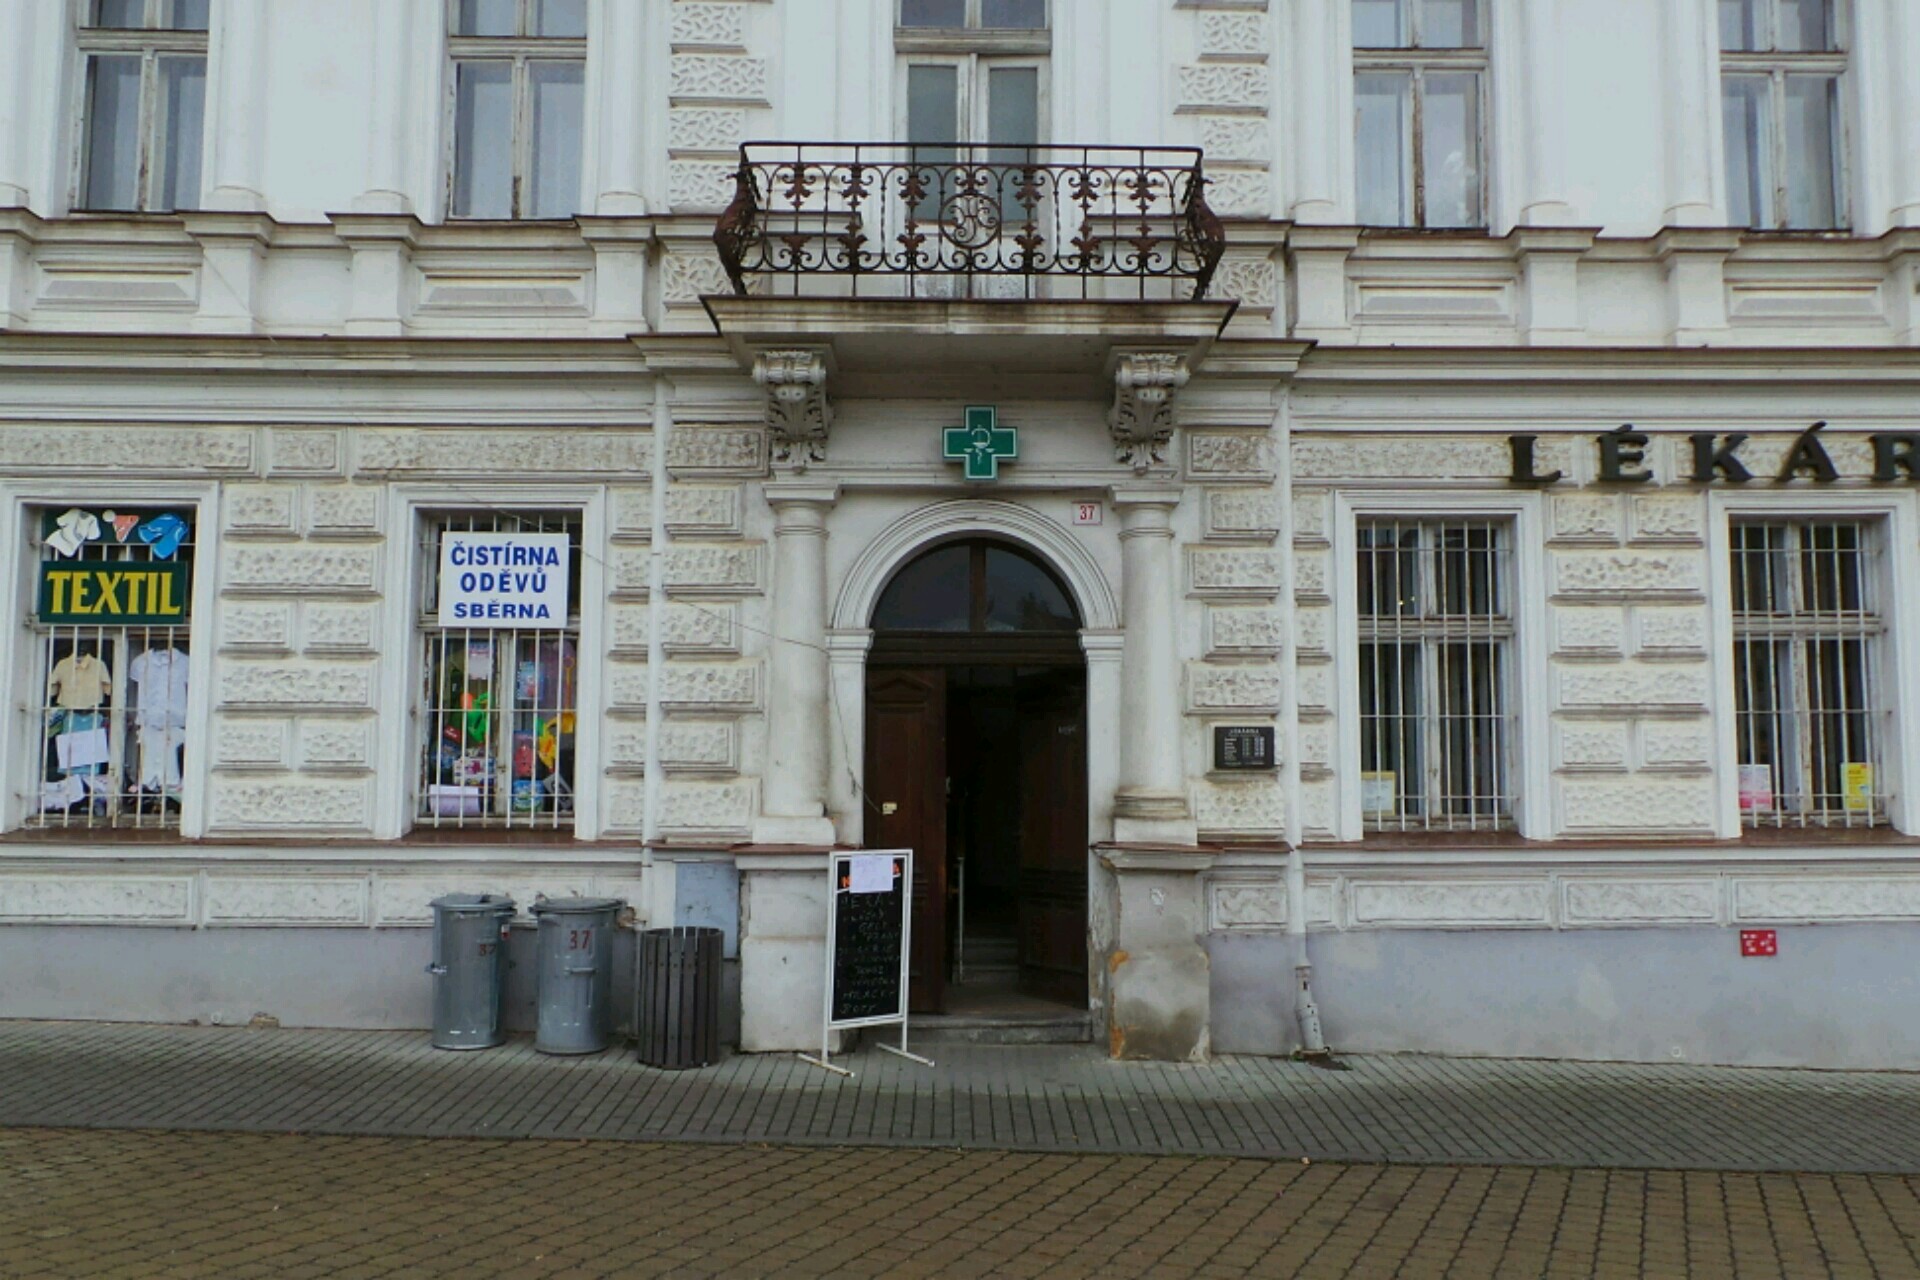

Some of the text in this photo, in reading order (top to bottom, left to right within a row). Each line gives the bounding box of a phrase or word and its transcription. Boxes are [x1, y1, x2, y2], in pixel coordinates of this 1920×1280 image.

[1080, 505, 1095, 520] 37
[450, 541, 559, 566] ČISTÍRNA
[460, 567, 546, 593] ODĚVŮ
[47, 570, 181, 615] TEXTIL
[454, 598, 550, 618] SBĚRNA
[569, 930, 592, 950] 37
